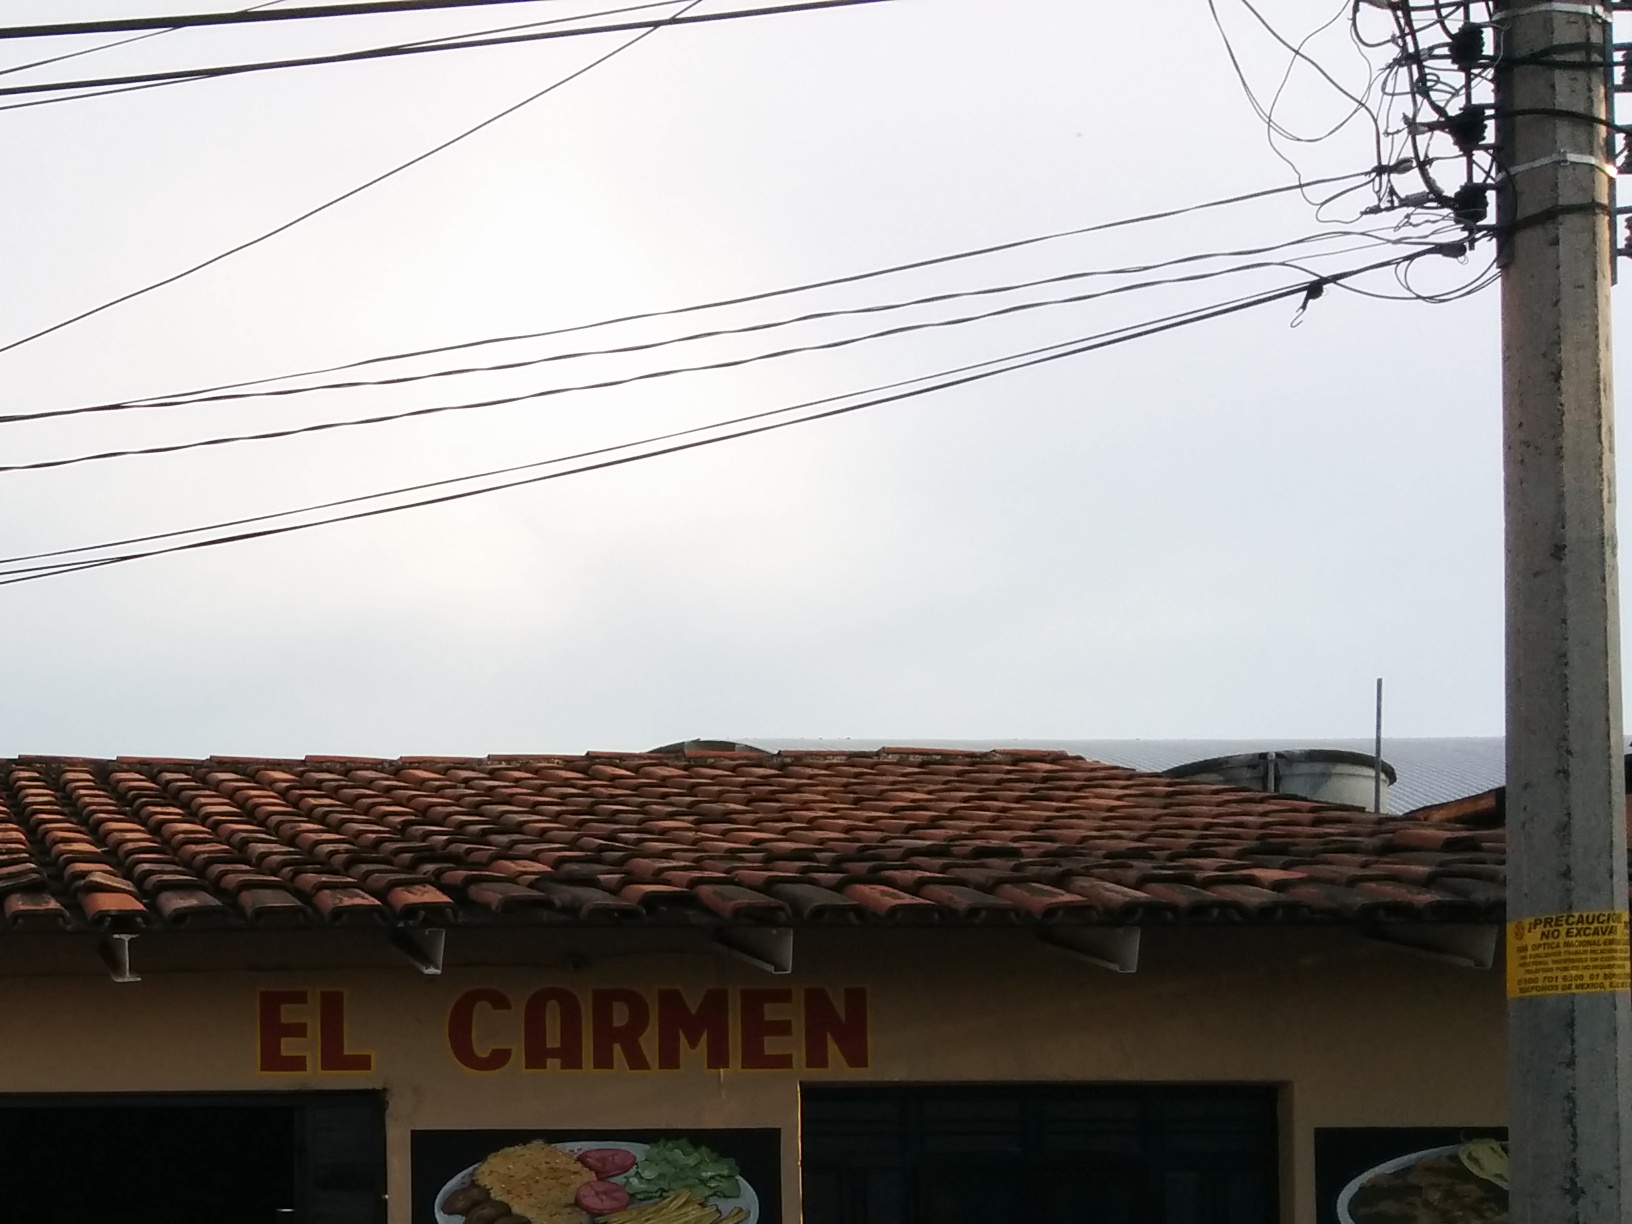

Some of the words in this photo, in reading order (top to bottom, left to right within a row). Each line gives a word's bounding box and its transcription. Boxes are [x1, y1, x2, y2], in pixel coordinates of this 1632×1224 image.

[1539, 929, 1561, 940] NO
[1565, 925, 1618, 938] EXCAVA
[257, 989, 374, 1074] EL
[446, 986, 872, 1073] CARMEN
